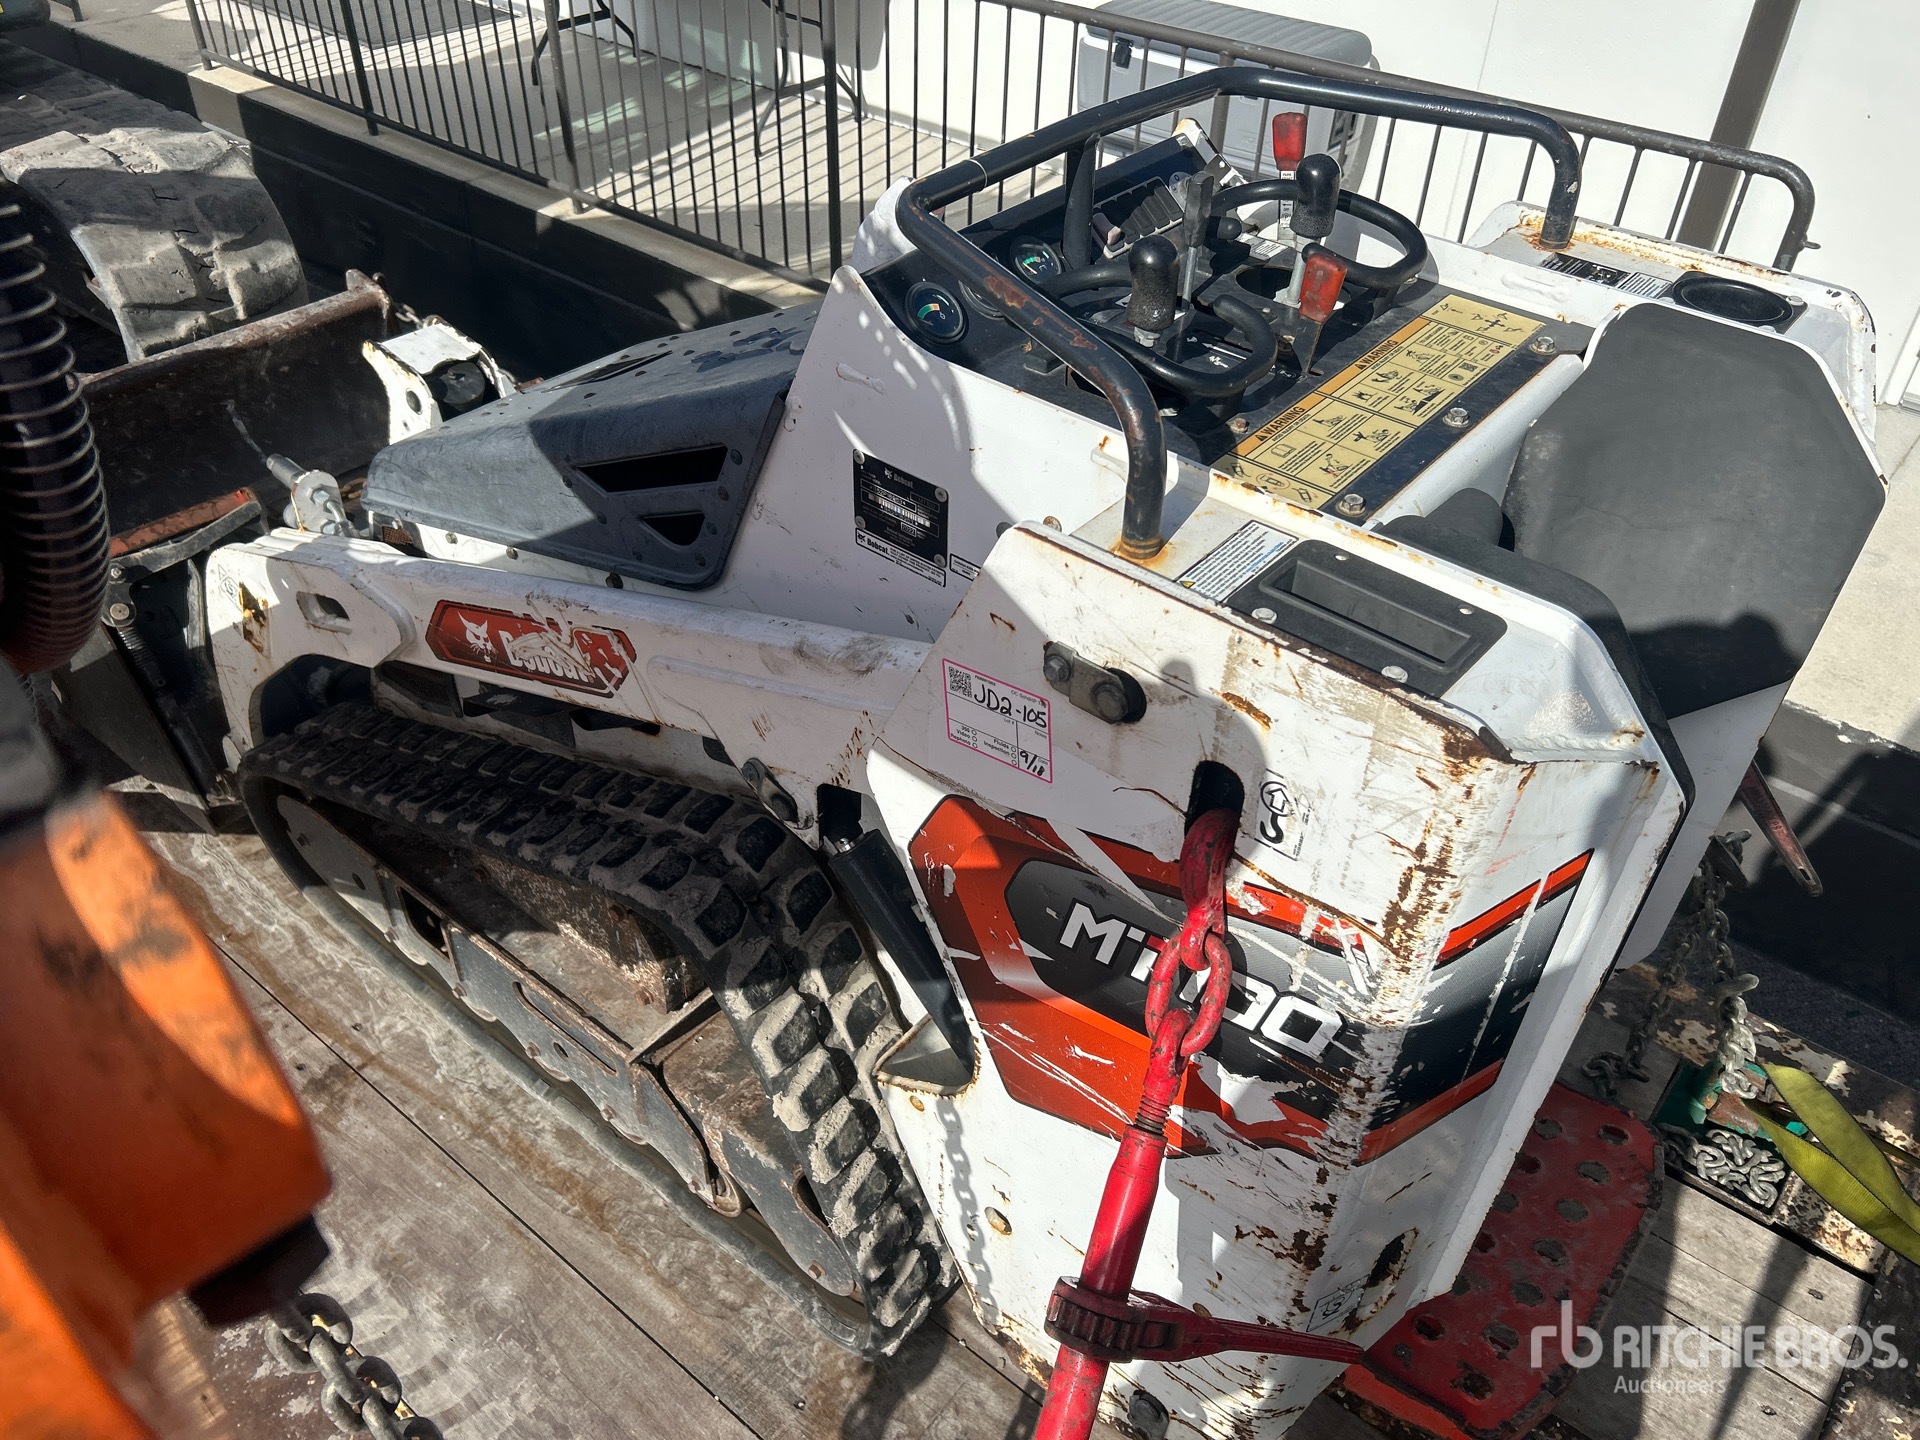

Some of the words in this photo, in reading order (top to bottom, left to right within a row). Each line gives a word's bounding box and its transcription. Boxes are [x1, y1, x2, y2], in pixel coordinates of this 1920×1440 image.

[1361, 339, 1399, 367] WARNING
[1261, 406, 1306, 435] WARNING
[867, 537, 889, 555] Bobcat
[974, 684, 1047, 728] JD2-105
[956, 728, 970, 739] Video
[983, 740, 1010, 756] Inspection
[993, 738, 1009, 749] Fluids
